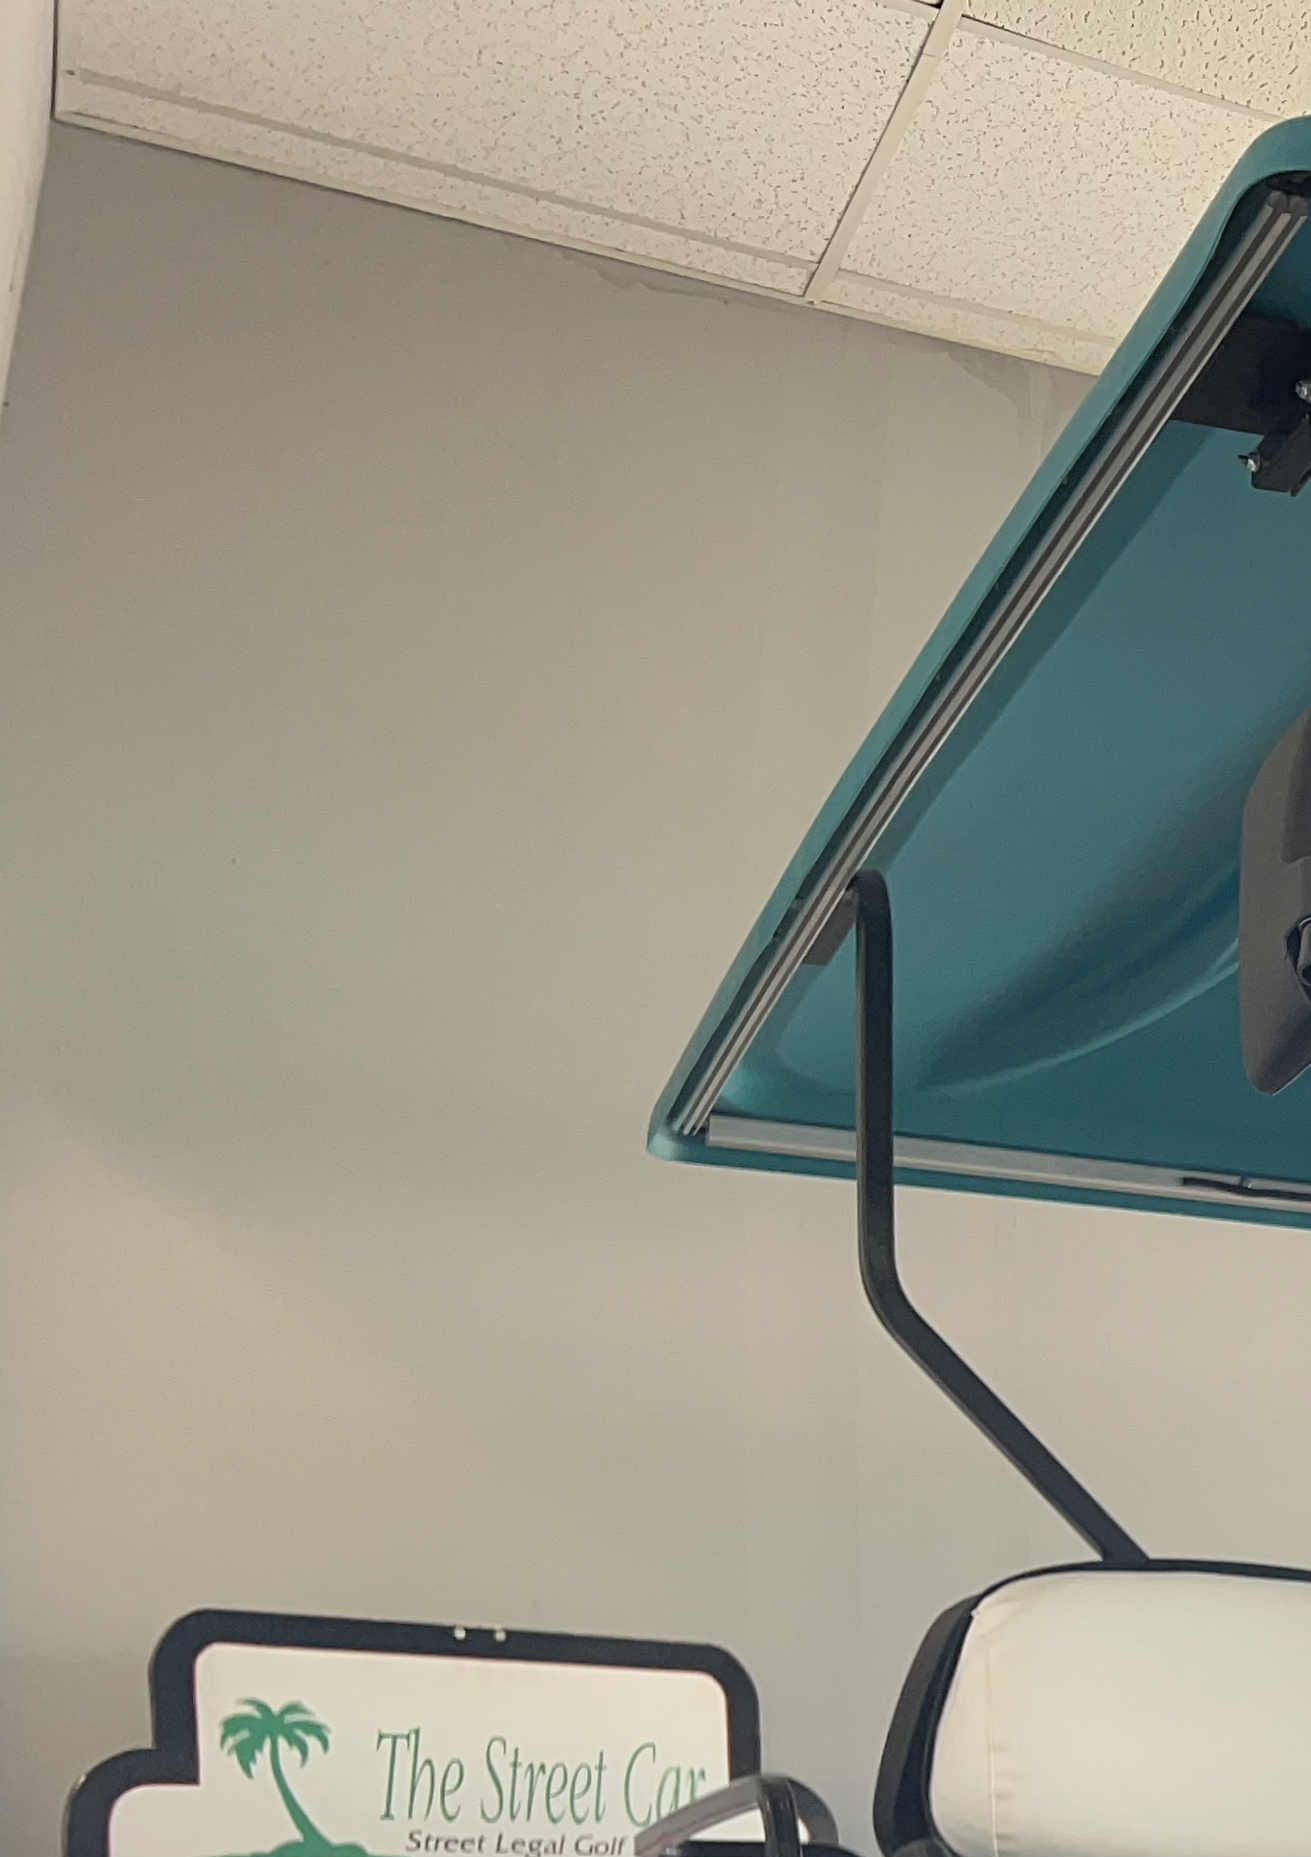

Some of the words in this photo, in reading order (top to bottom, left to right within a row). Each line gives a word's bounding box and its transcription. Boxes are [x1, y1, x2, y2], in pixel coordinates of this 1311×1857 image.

[375, 1726, 466, 1824] The
[480, 1734, 608, 1826] Street
[405, 1830, 486, 1855] Street
[574, 1834, 627, 1857] Golf
